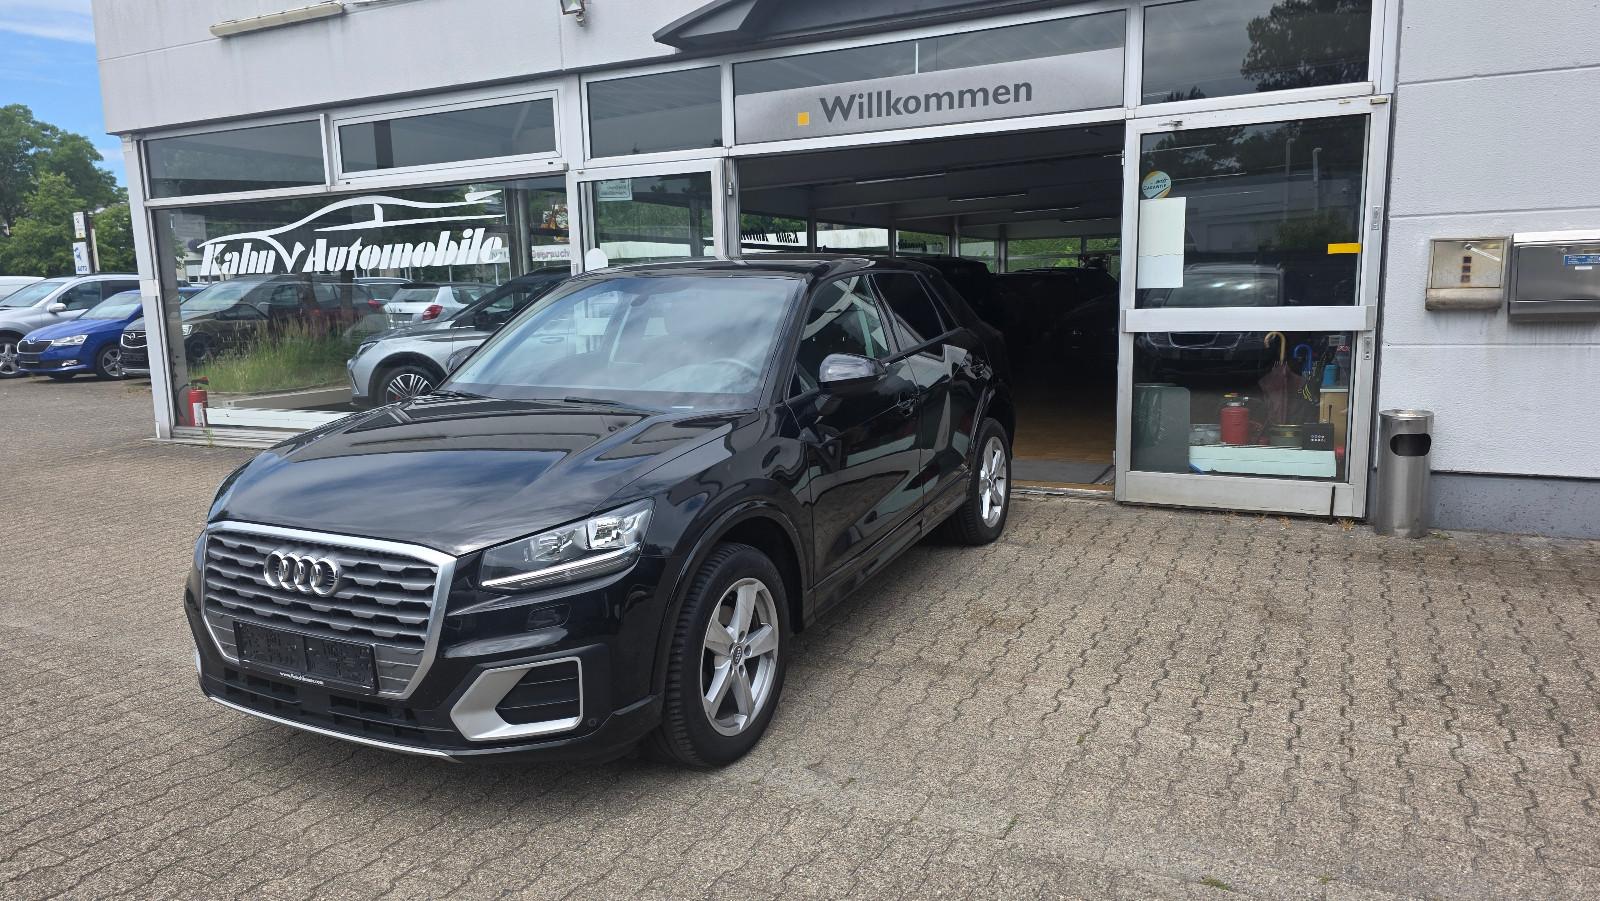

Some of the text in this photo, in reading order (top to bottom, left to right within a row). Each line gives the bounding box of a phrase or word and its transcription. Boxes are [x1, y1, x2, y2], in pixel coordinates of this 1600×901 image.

[819, 81, 1032, 123] Willkommen
[200, 228, 502, 275] Kahn Automobile
